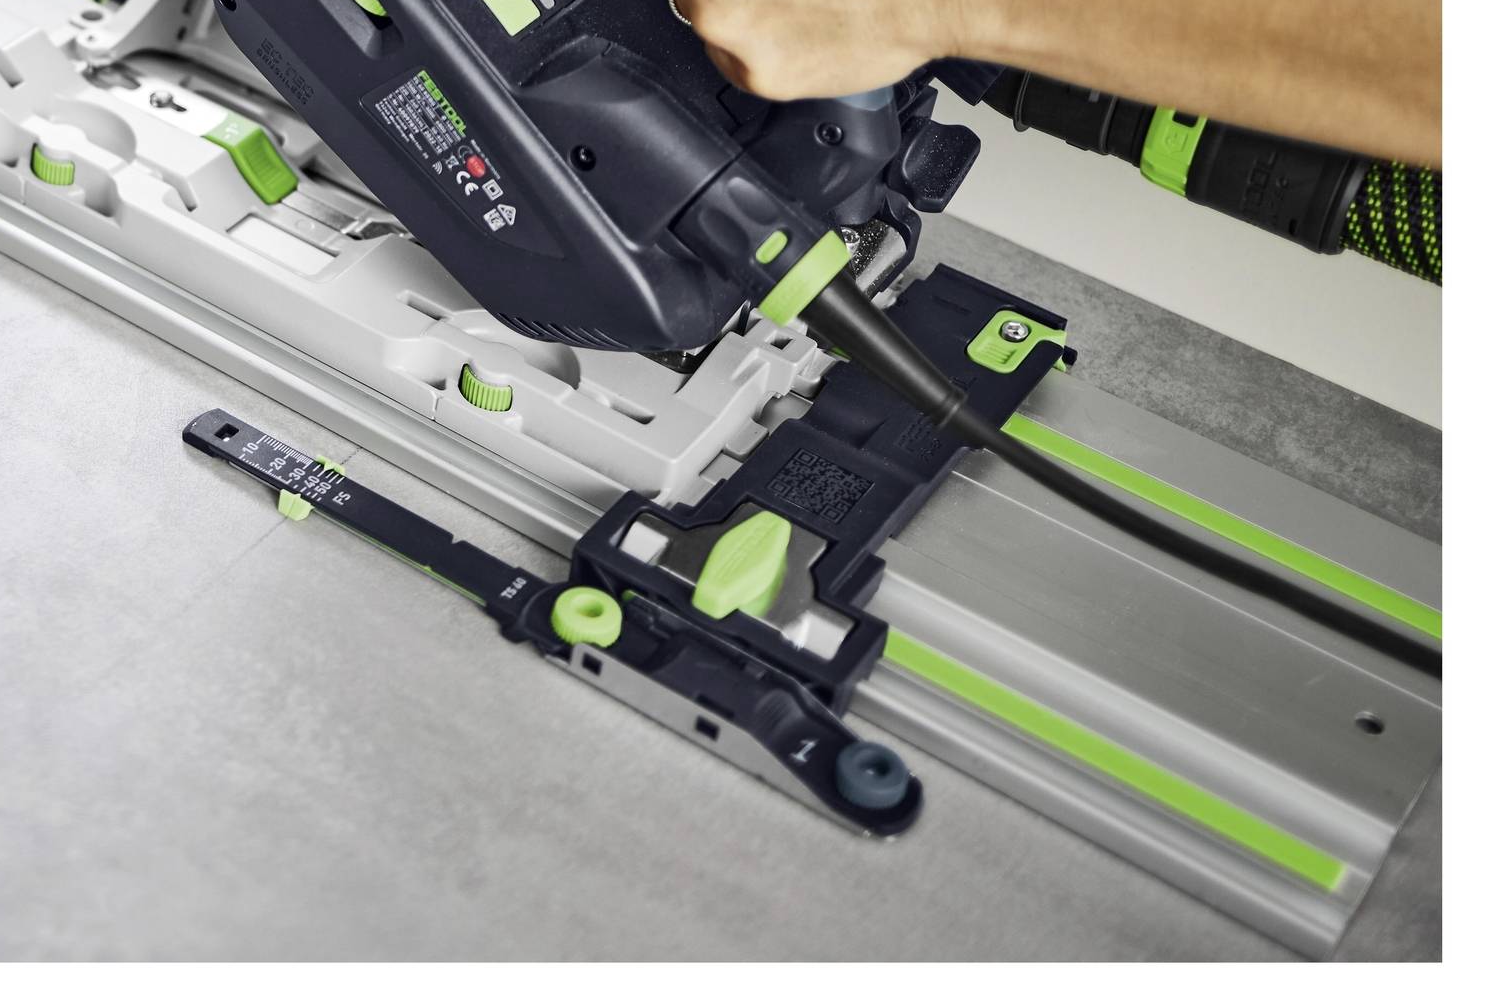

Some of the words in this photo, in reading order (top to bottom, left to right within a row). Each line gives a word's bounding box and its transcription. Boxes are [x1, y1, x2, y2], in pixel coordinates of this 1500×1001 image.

[417, 70, 466, 138] FESTOOL
[242, 442, 259, 454] 10
[269, 457, 286, 470] 20
[288, 468, 306, 480] 30
[304, 476, 320, 488] 40
[314, 481, 332, 494] 50
[332, 491, 351, 506] FS
[500, 586, 517, 599] TS
[513, 577, 527, 590] 60
[788, 738, 820, 764] 1
